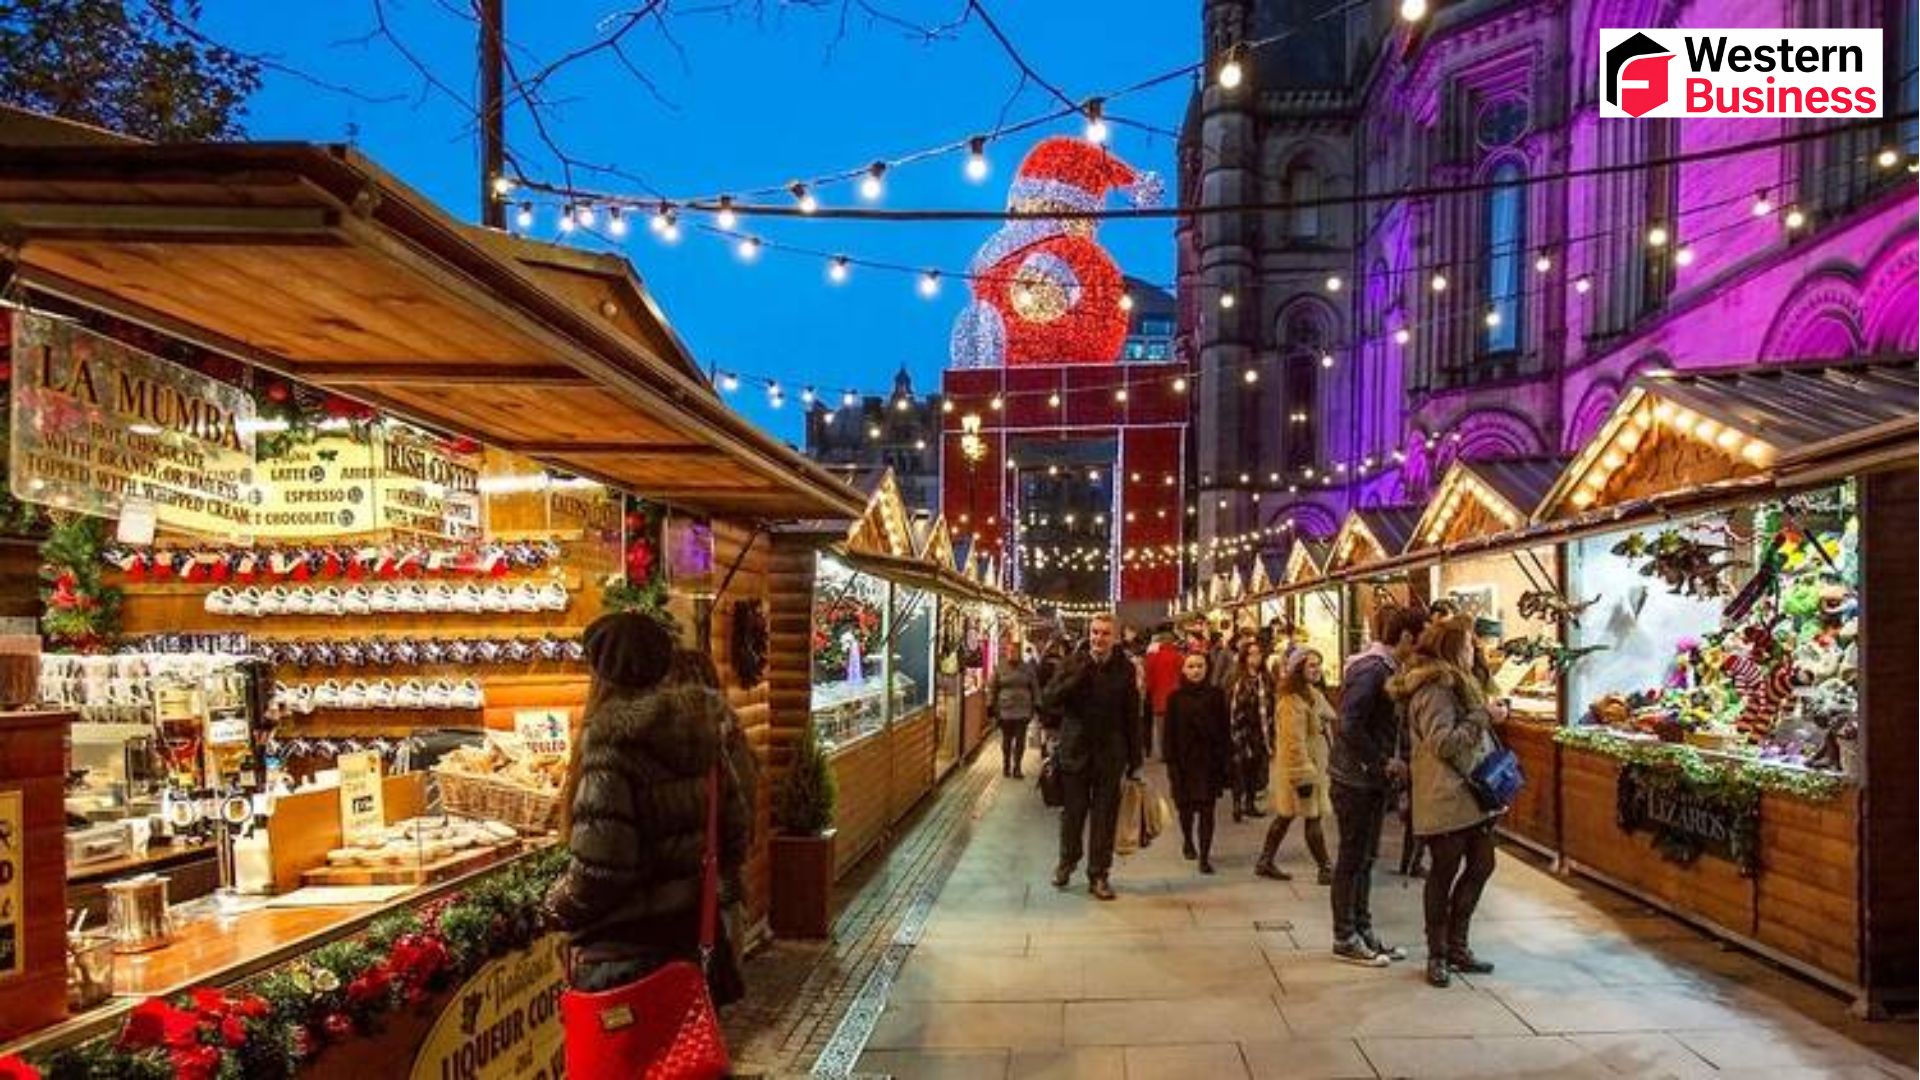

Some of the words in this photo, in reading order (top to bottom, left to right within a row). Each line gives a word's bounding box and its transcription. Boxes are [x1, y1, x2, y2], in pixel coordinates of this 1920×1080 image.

[40, 345, 98, 404] LA
[118, 372, 243, 451] MUMBA
[27, 452, 90, 483] TOPPED
[271, 468, 306, 482] LATTE
[384, 439, 425, 480] IRISH
[429, 457, 479, 495] COFFEE
[285, 490, 345, 504] ESPRESSO
[266, 511, 336, 526] CHOCOLATE
[441, 1007, 525, 1080] LIQUEUR
